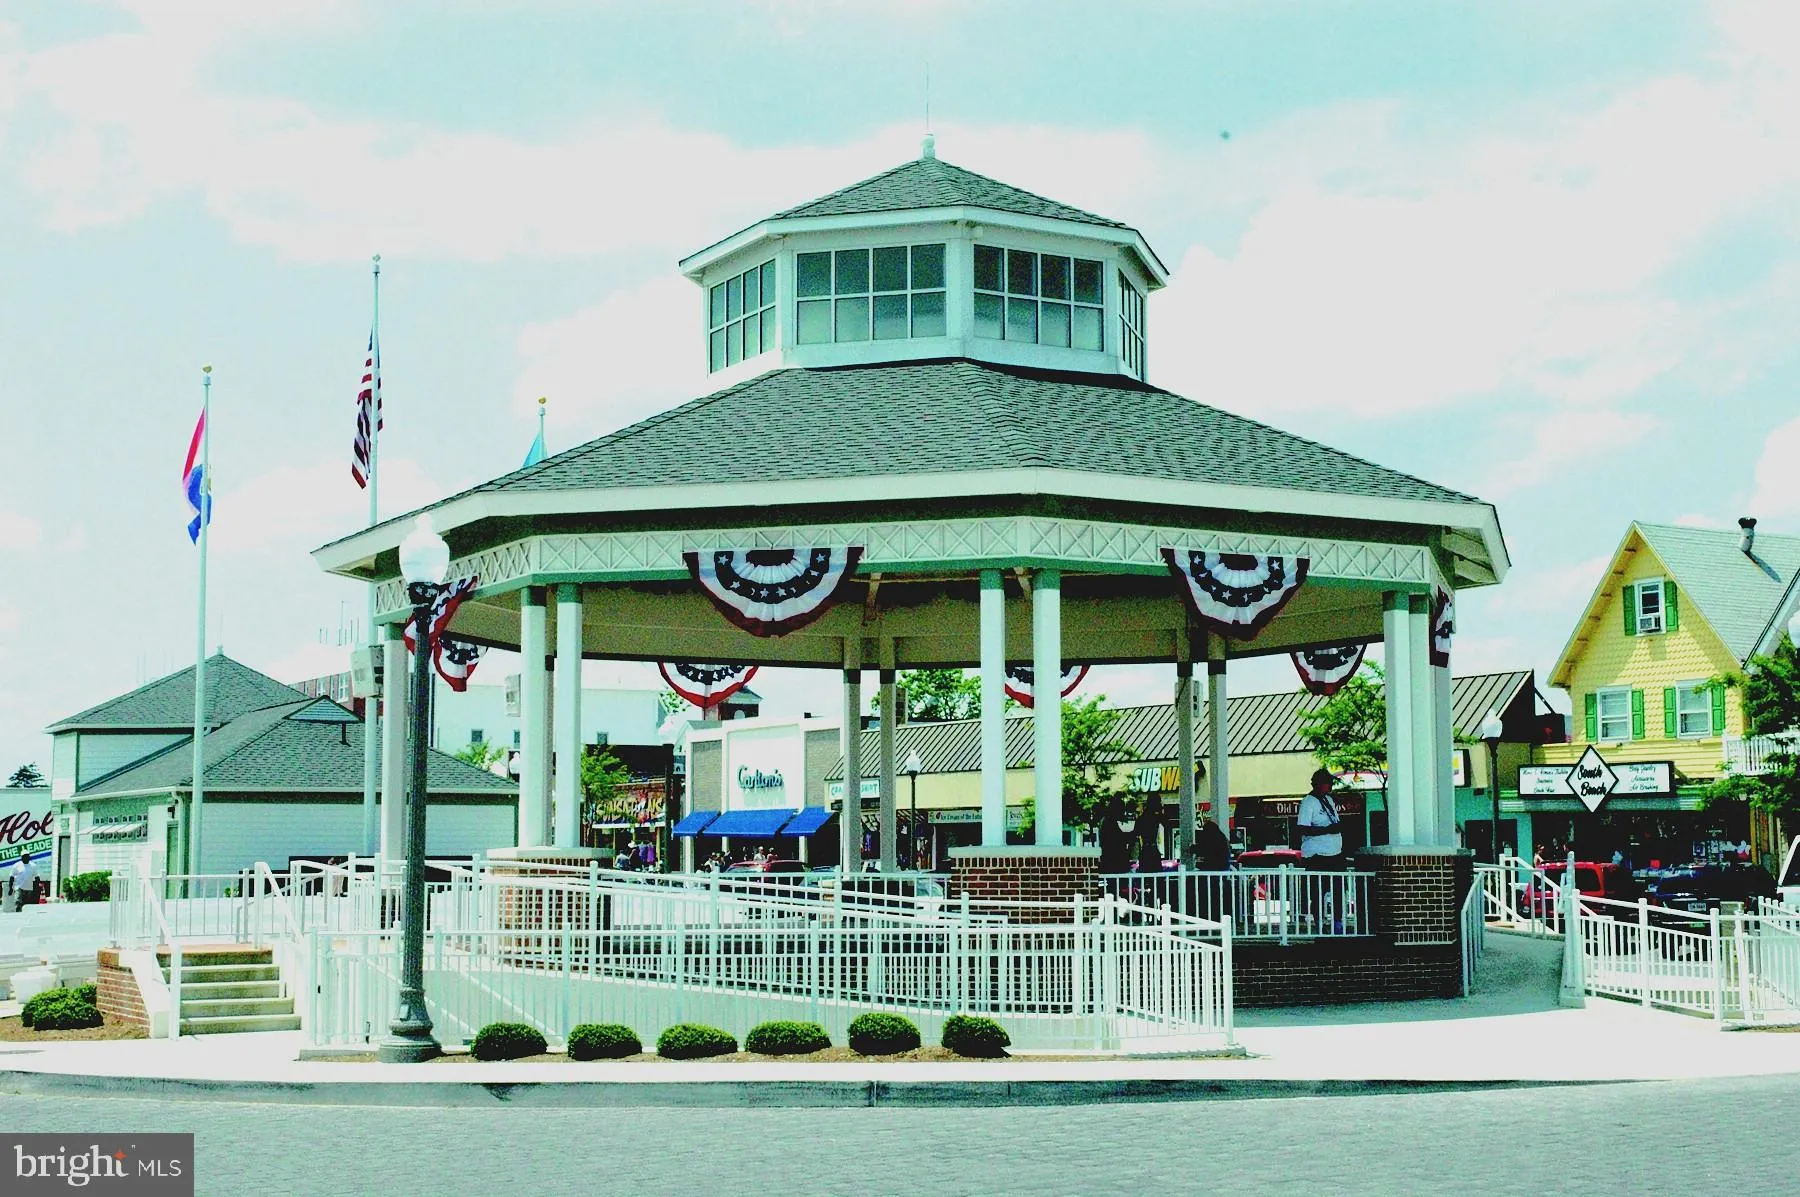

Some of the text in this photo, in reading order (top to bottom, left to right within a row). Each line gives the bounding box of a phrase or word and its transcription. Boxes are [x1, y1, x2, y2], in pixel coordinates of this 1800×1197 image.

[738, 765, 784, 789] Carlton's
[1129, 766, 1181, 792] SUBWA
[1578, 765, 1603, 780] South
[1581, 782, 1607, 796] Beach
[1276, 803, 1292, 814] Old
[0, 840, 52, 860] THE LEADE
